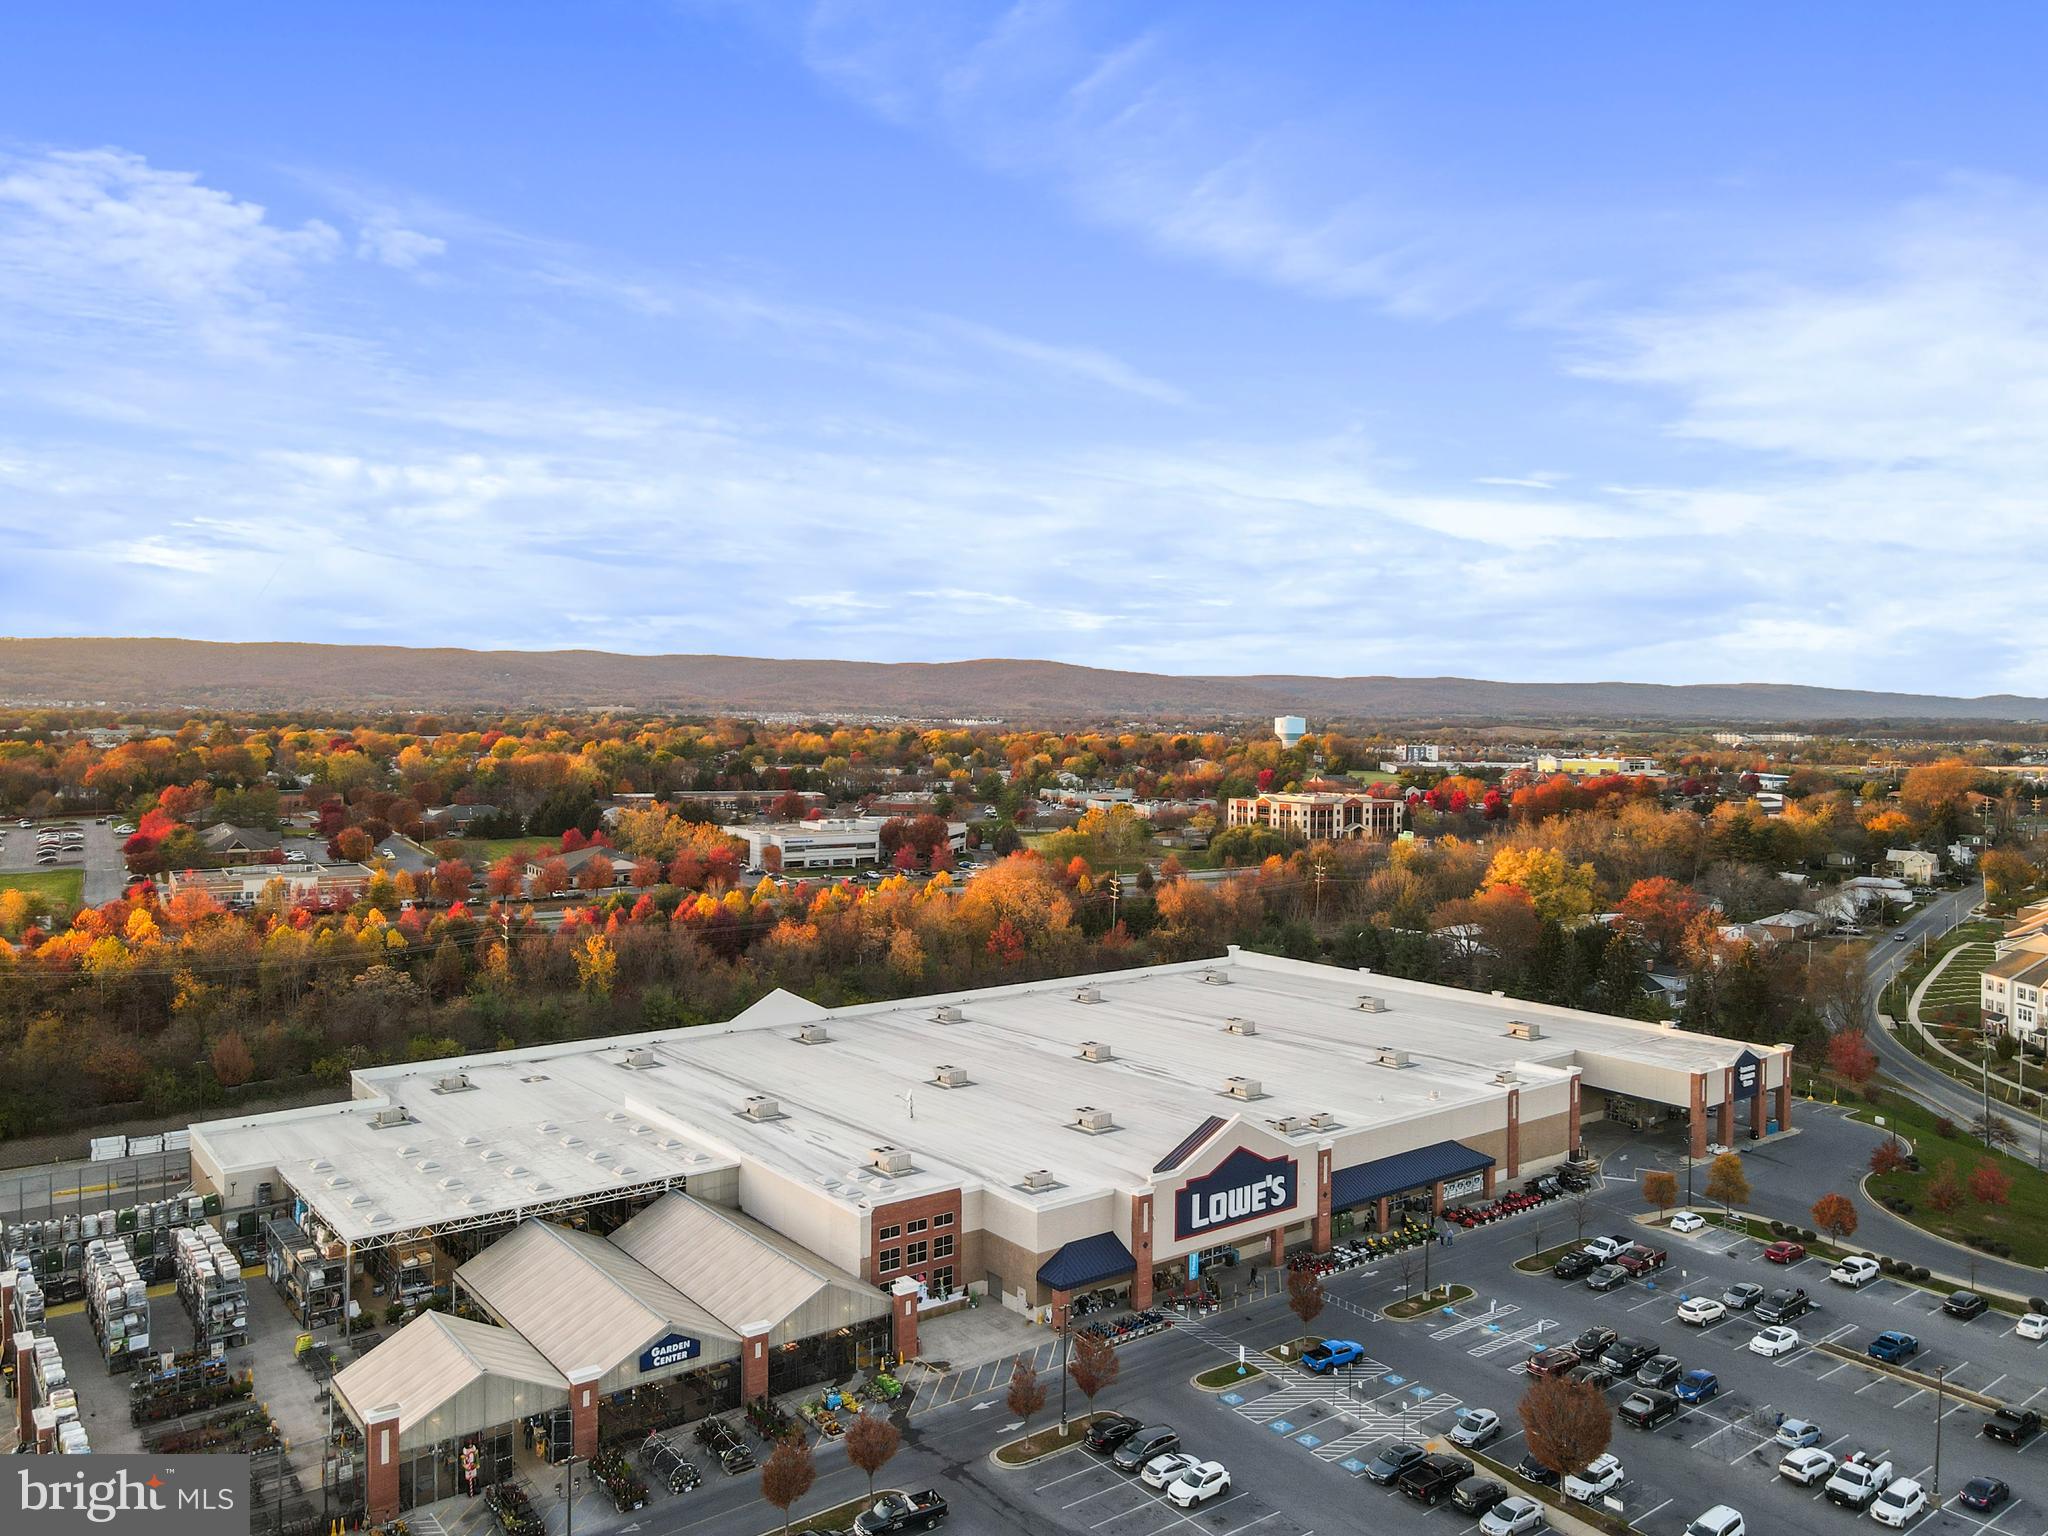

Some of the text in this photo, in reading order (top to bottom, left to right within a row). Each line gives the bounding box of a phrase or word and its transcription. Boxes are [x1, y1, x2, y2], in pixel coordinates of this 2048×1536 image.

[1191, 1174, 1287, 1229] LOWE'S
[651, 1340, 691, 1357] GARDEN
[653, 1351, 688, 1367] CENTER
